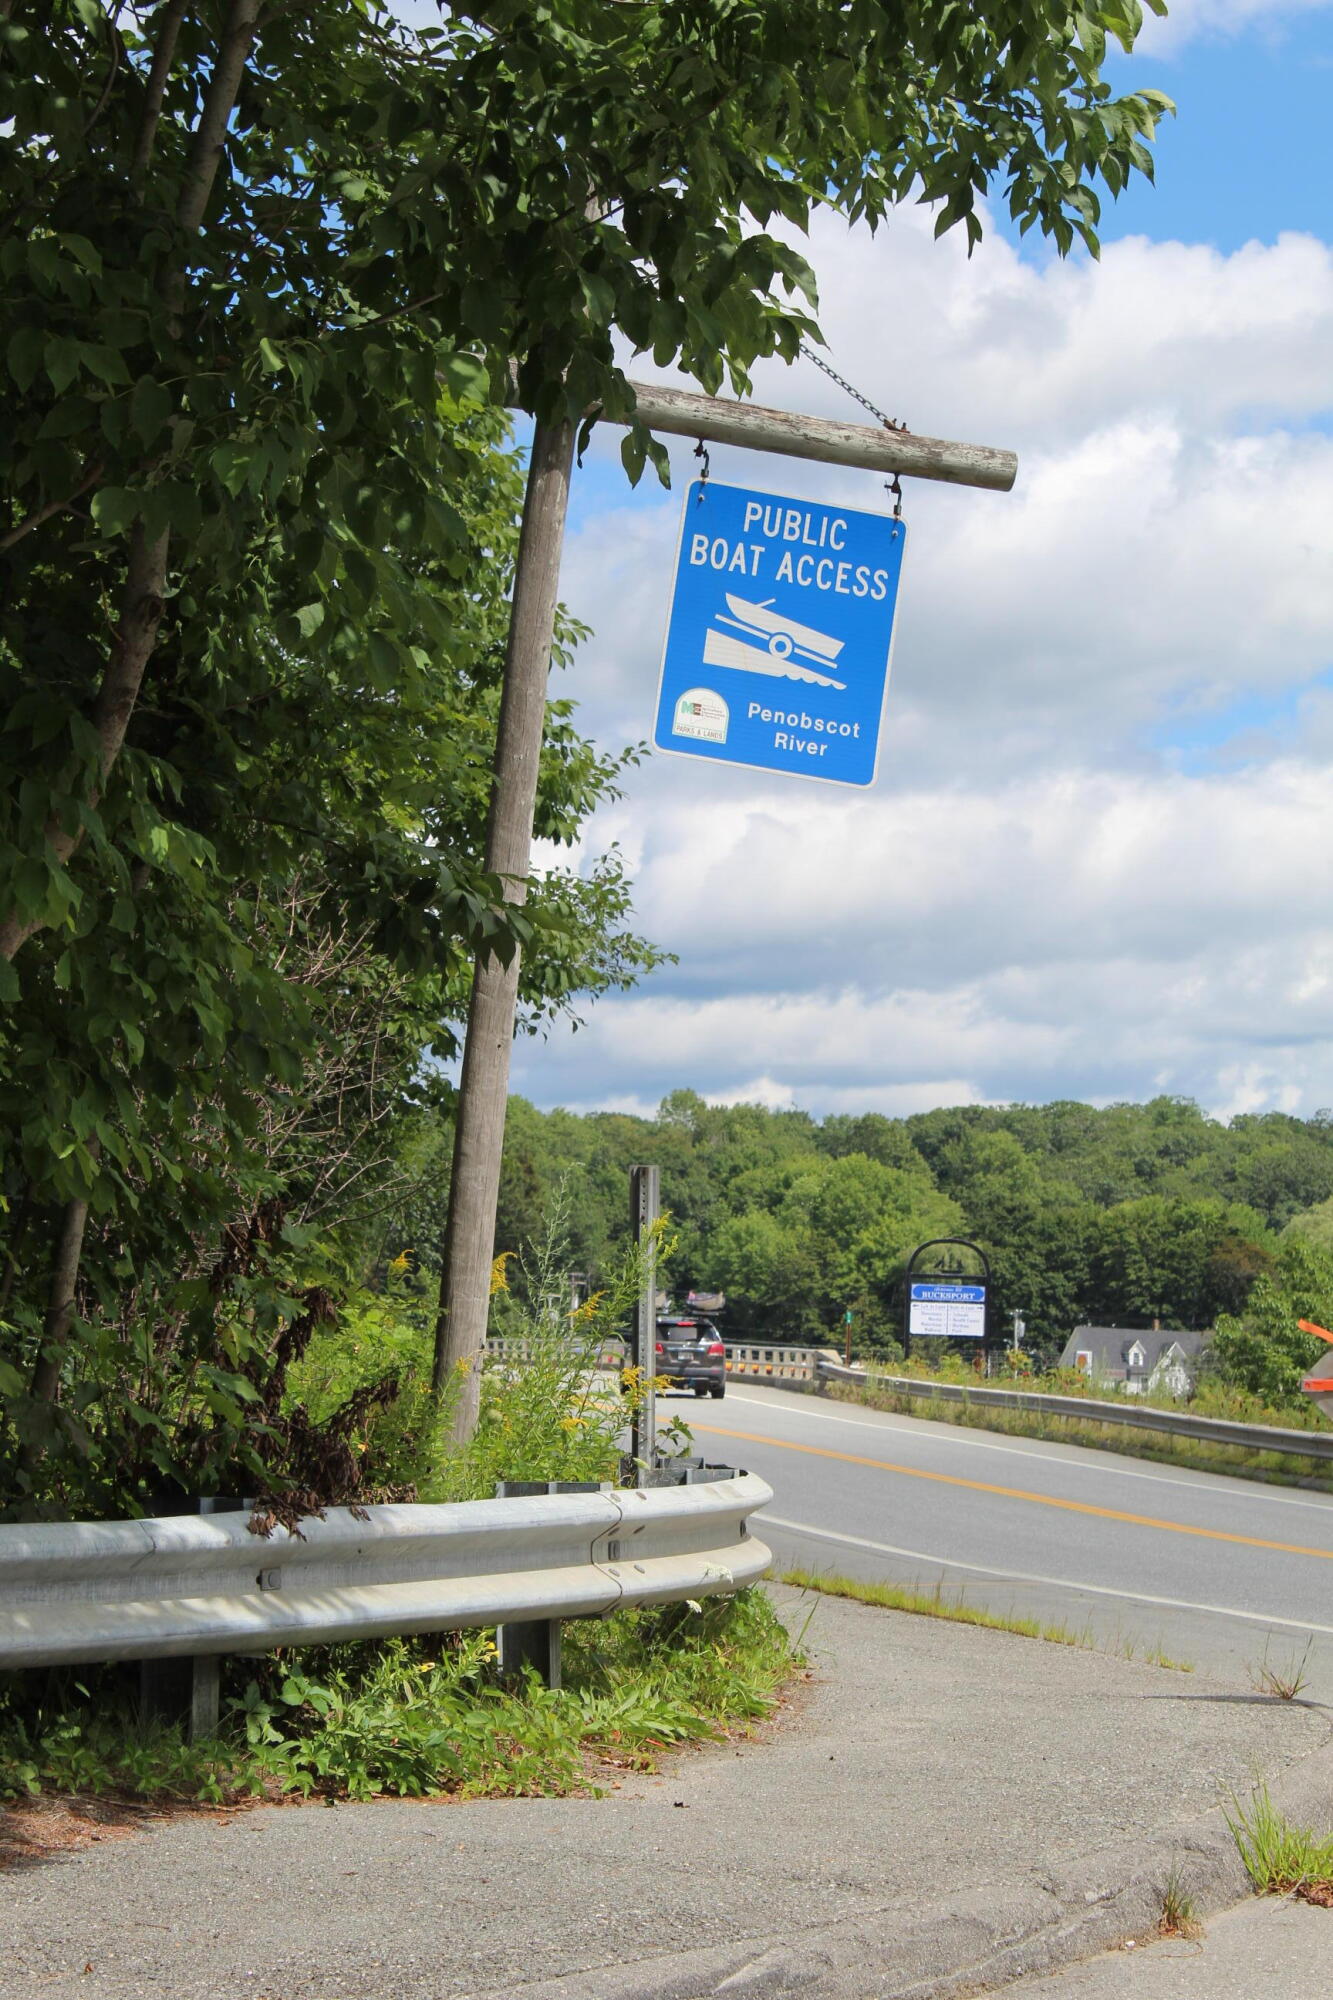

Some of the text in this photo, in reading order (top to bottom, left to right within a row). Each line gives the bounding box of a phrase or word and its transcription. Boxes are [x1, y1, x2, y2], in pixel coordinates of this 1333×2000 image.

[744, 502, 847, 550] PUBLIC
[689, 533, 889, 601] BOAT ACCESS
[676, 725, 695, 734] PARKS
[703, 730, 722, 739] LANDS
[748, 702, 861, 739] Penobscot
[774, 731, 828, 757] River
[922, 1291, 975, 1300] BUCKSPORT
